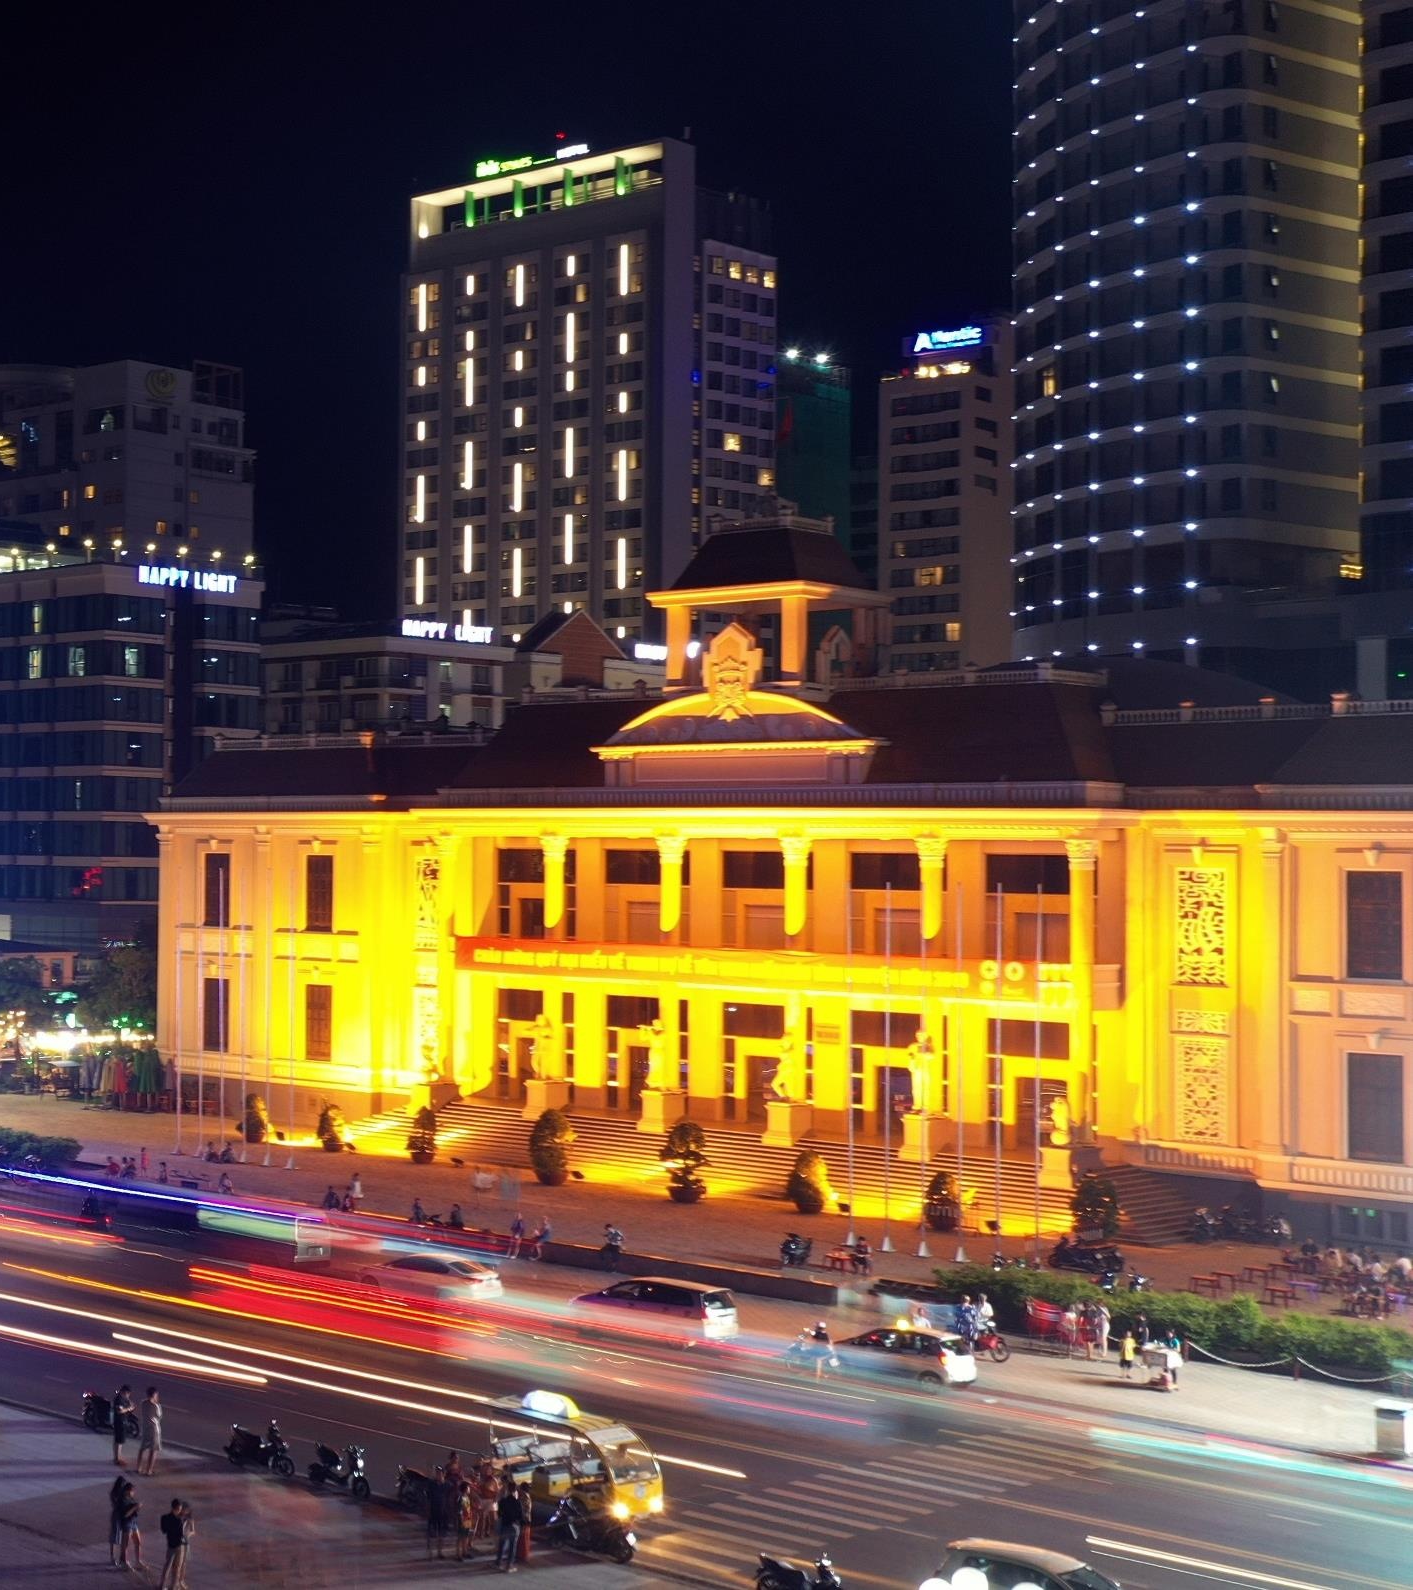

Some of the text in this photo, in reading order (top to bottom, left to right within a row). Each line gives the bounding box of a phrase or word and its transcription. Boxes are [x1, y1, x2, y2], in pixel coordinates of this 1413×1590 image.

[138, 565, 238, 594] HAPPY LIGHT
[402, 619, 448, 639] HAPPY
